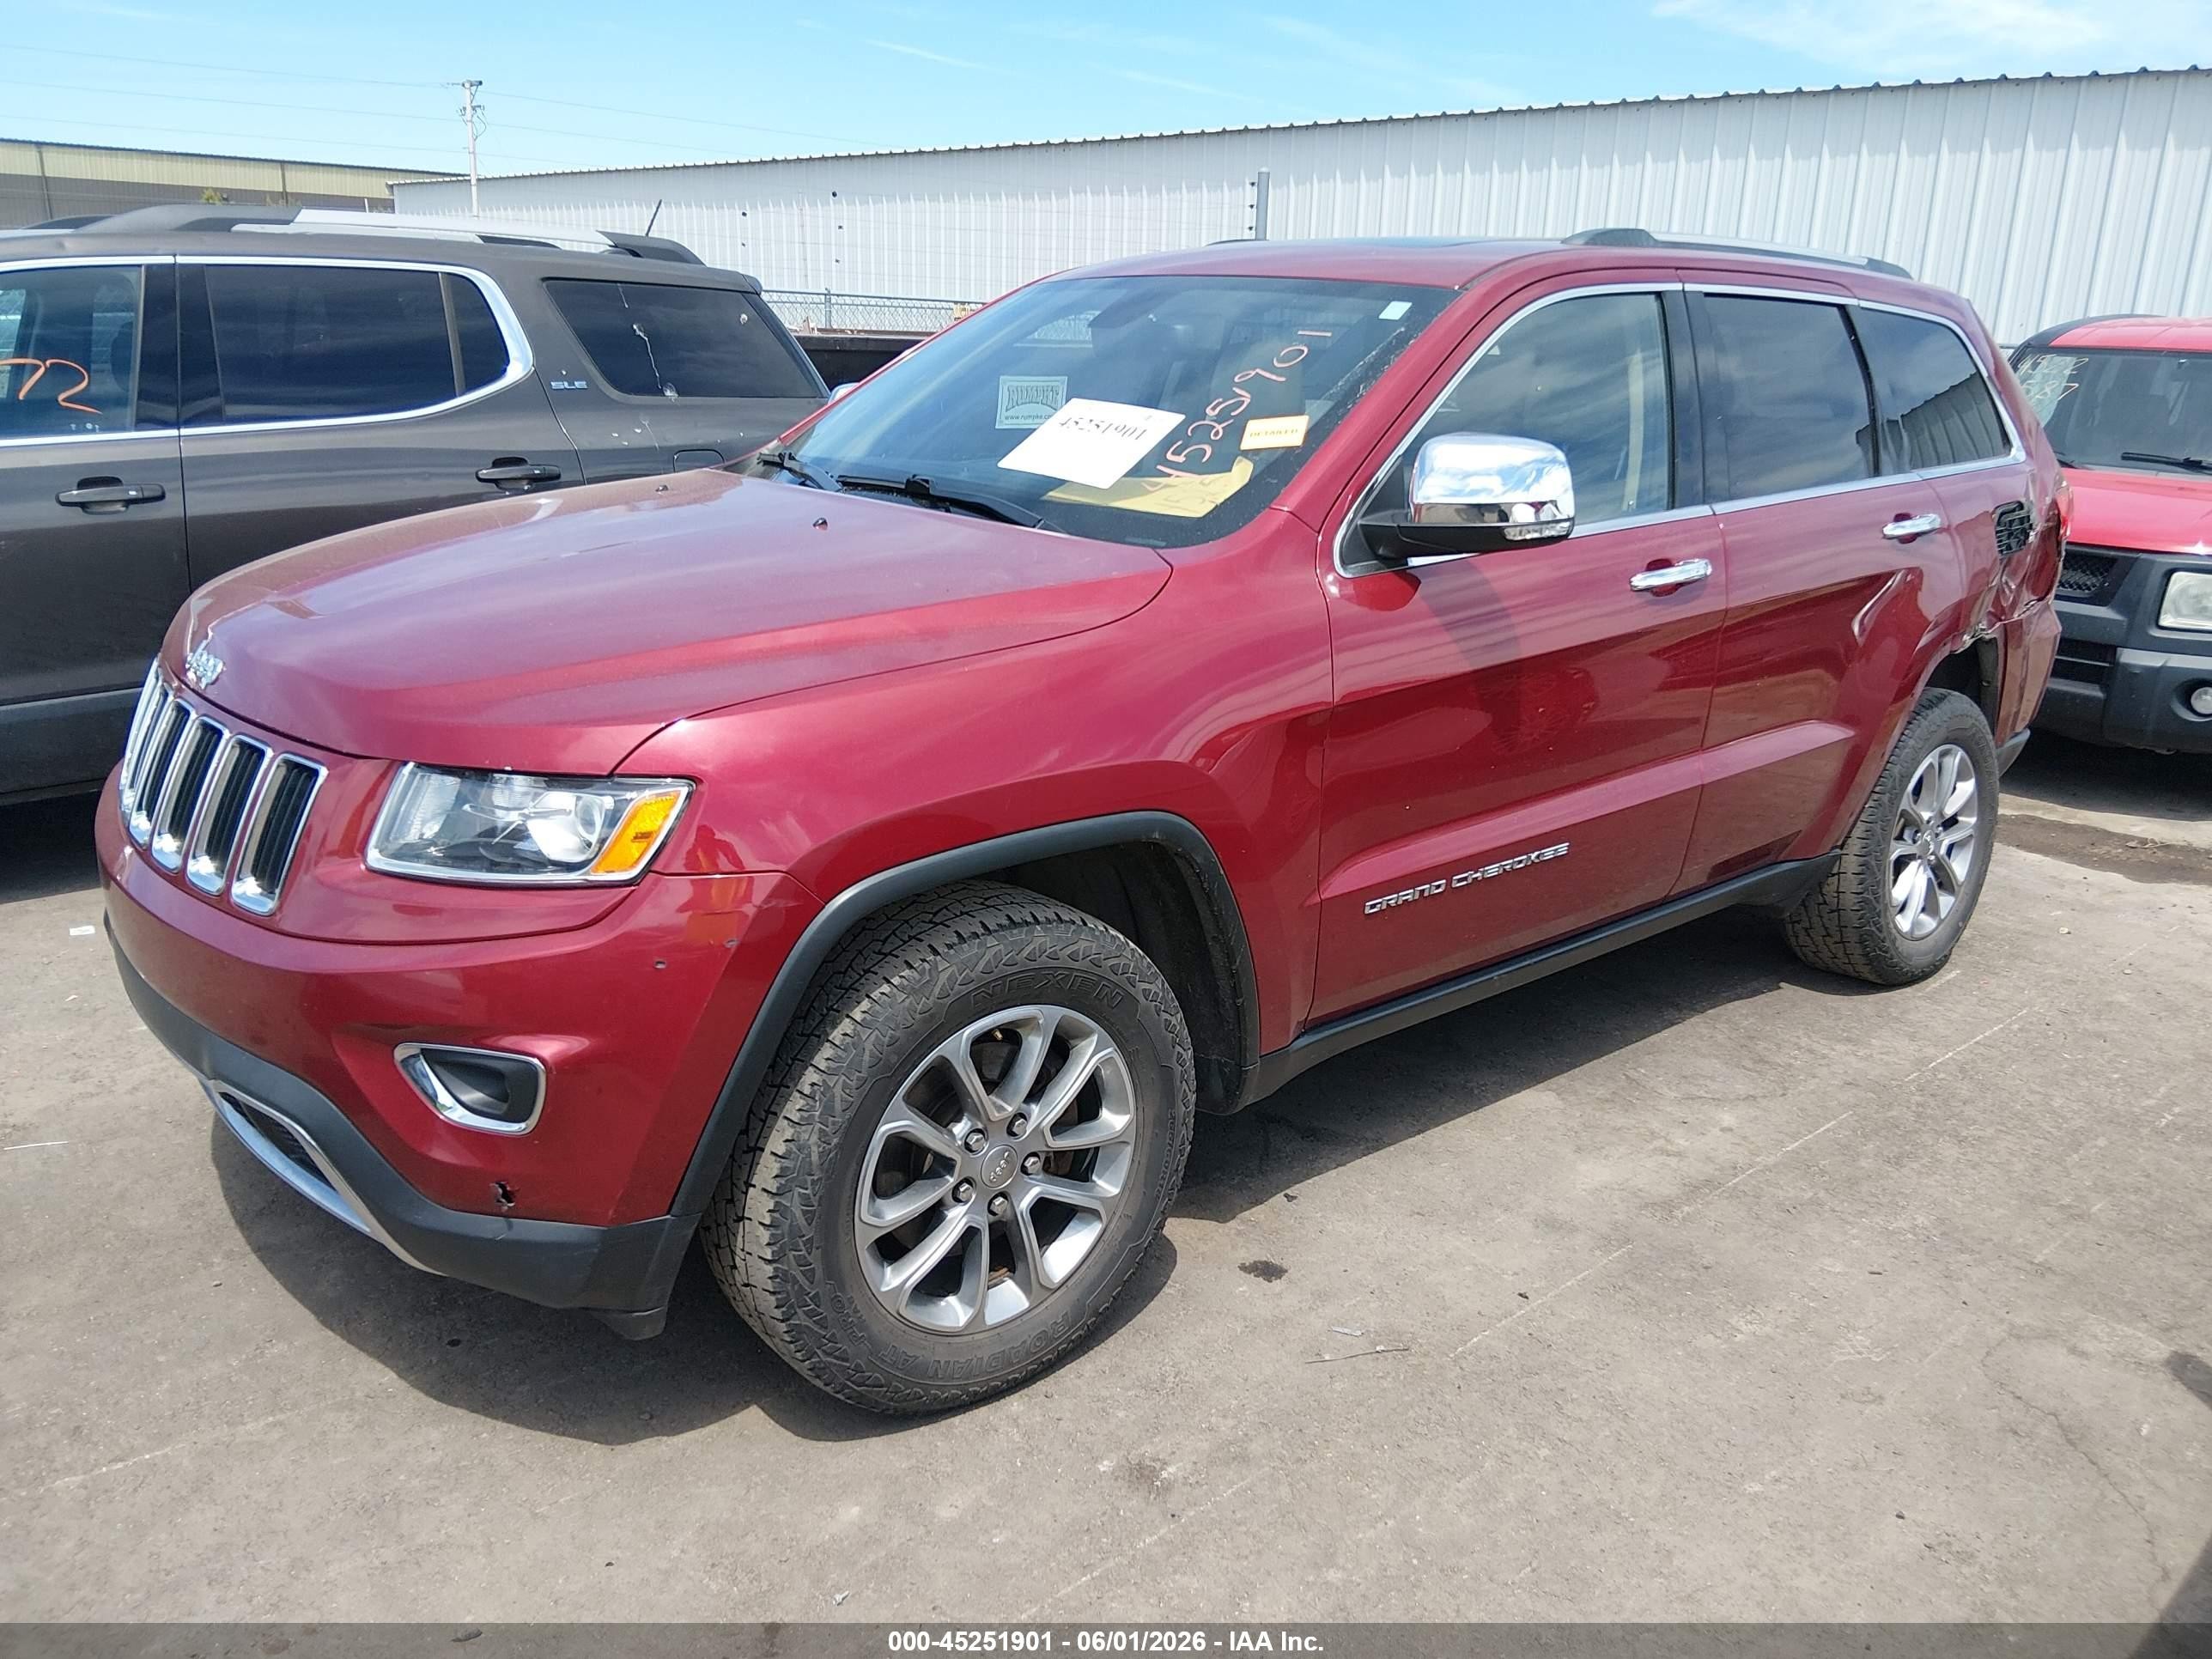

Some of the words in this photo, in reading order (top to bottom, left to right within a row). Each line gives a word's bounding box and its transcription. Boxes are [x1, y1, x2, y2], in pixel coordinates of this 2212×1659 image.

[550, 380, 588, 389] SLE
[1006, 384, 1060, 412] RUMPKE
[1141, 329, 1333, 493] 45251901
[1364, 879, 1446, 915] GRAND
[1451, 842, 1571, 888] CHEROKEE
[970, 971, 1126, 1010] NEXEN
[878, 1343, 922, 1370] AT
[927, 1310, 1075, 1380] ROADIAN
